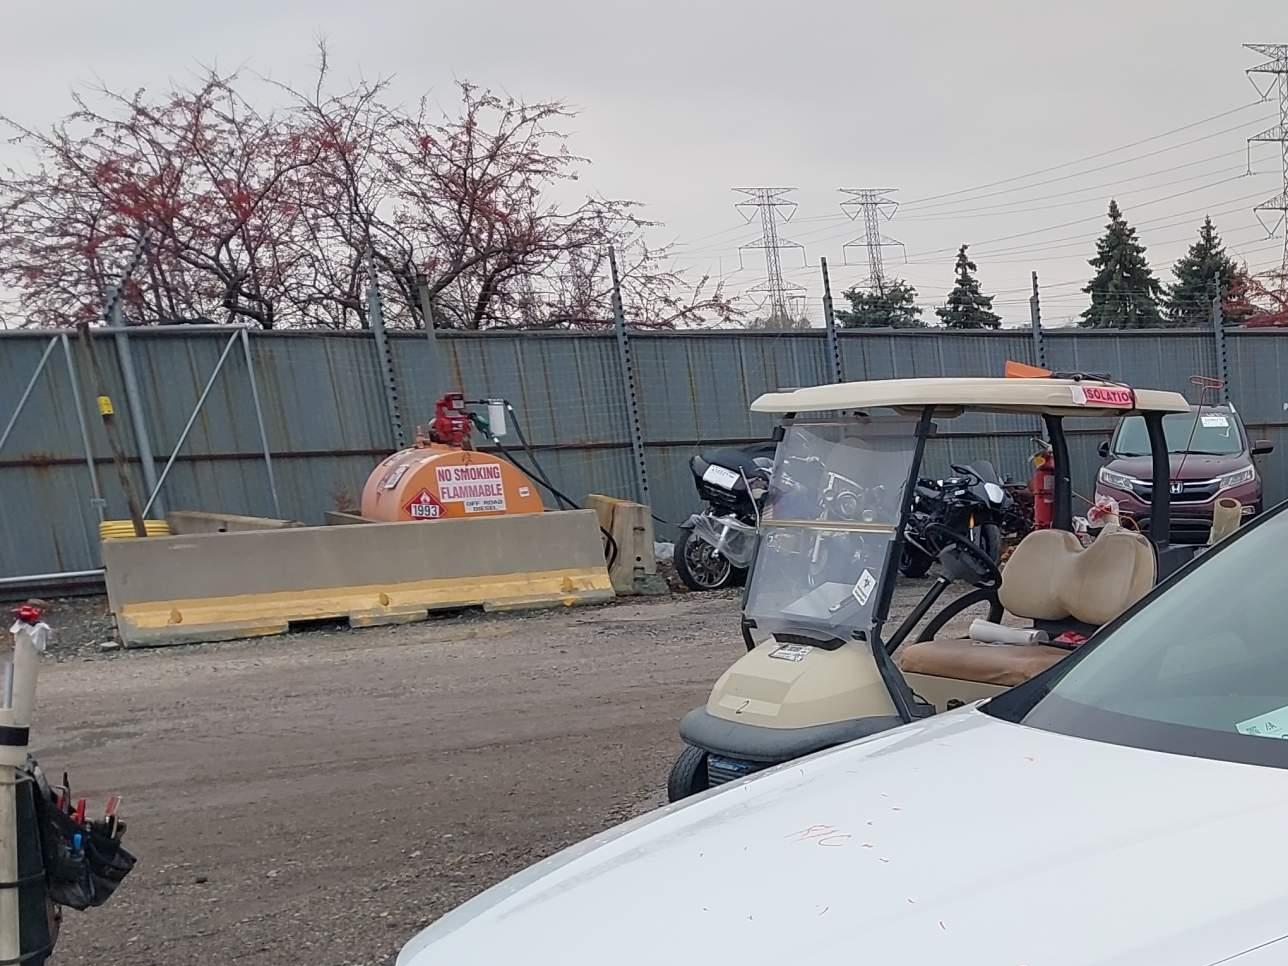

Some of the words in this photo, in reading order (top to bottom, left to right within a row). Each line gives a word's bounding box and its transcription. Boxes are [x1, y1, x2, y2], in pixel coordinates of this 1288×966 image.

[438, 468, 452, 482] NO
[454, 466, 500, 481] SMOKING
[441, 484, 503, 500] FLAMMABLE
[413, 504, 439, 517] 1993
